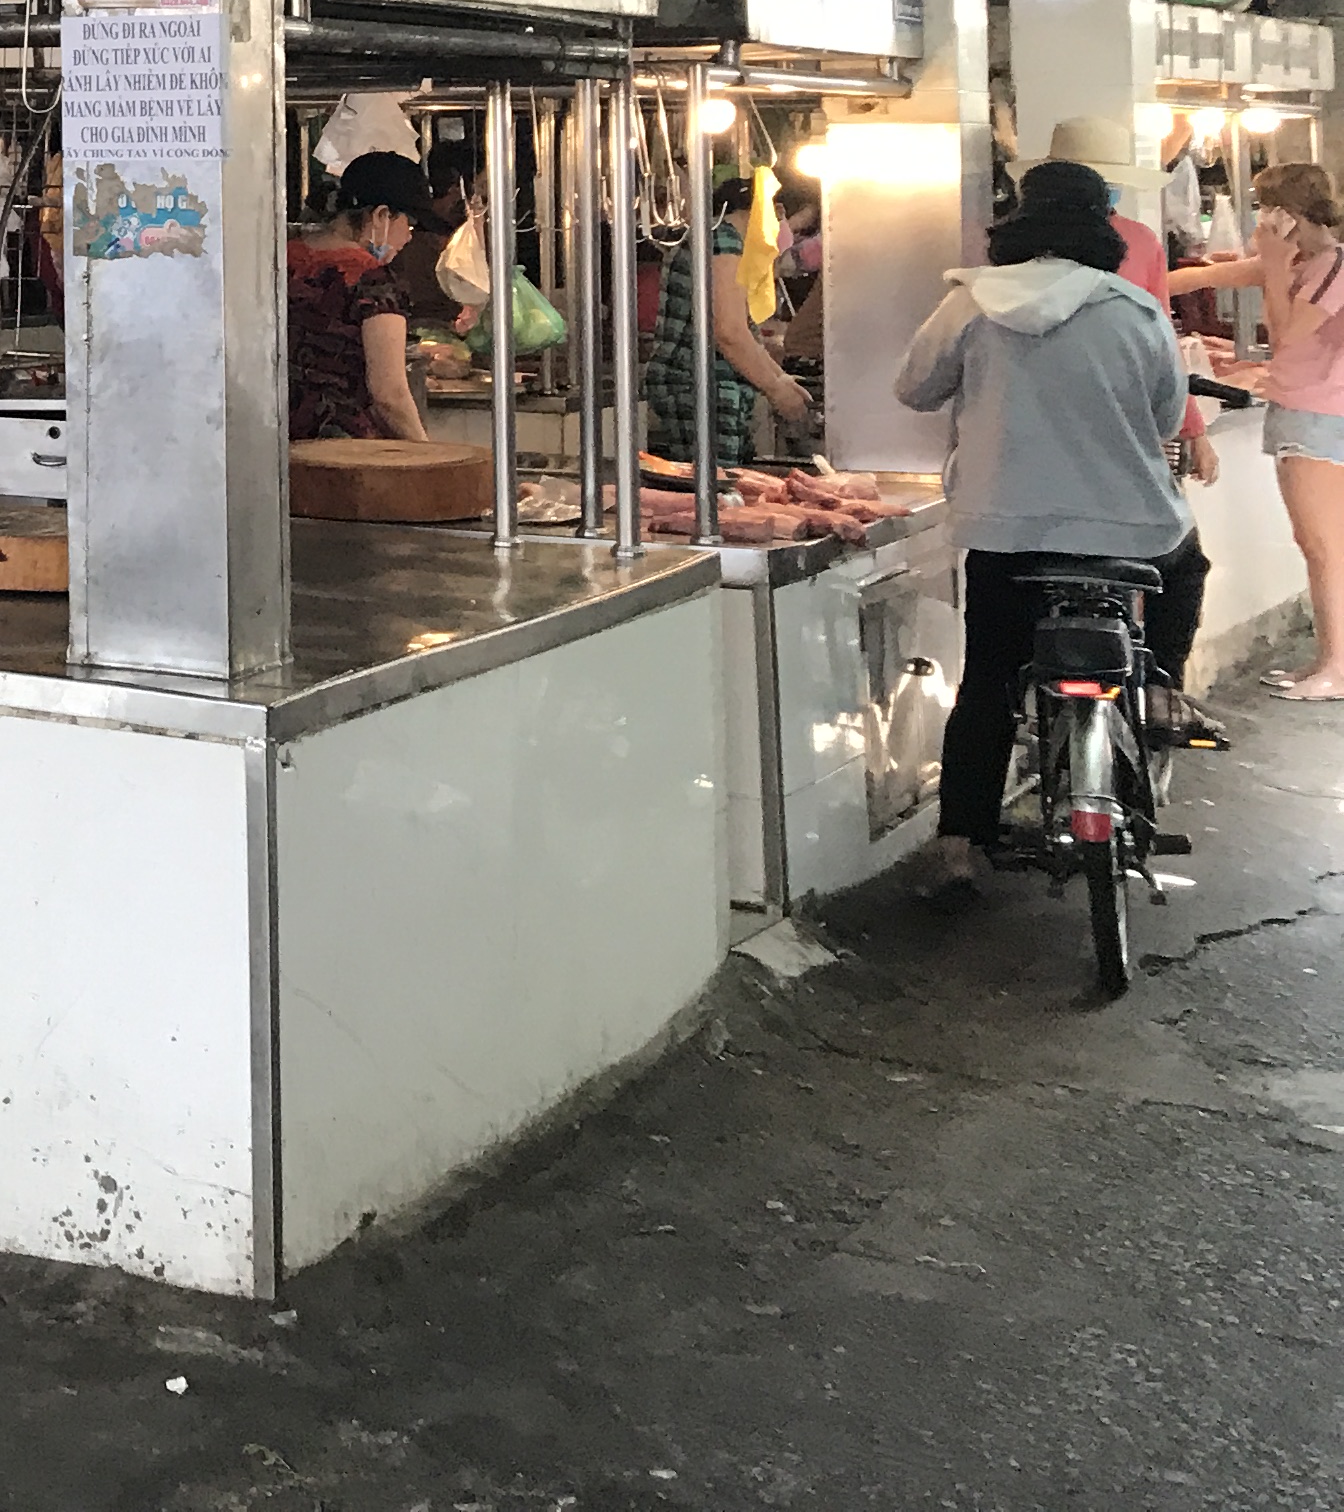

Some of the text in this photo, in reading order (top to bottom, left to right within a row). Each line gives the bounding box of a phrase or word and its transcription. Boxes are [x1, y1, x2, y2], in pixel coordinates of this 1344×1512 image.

[122, 22, 135, 39] ĐI
[139, 22, 156, 39] RA
[143, 42, 170, 65] XÚC
[196, 46, 211, 64] AI
[95, 69, 122, 92] LÂY
[64, 100, 102, 118] MANG
[81, 120, 207, 144] CHO GIA ĐÌNH MÌNH
[83, 149, 124, 159] CHUNG
[127, 149, 148, 159] TAY
